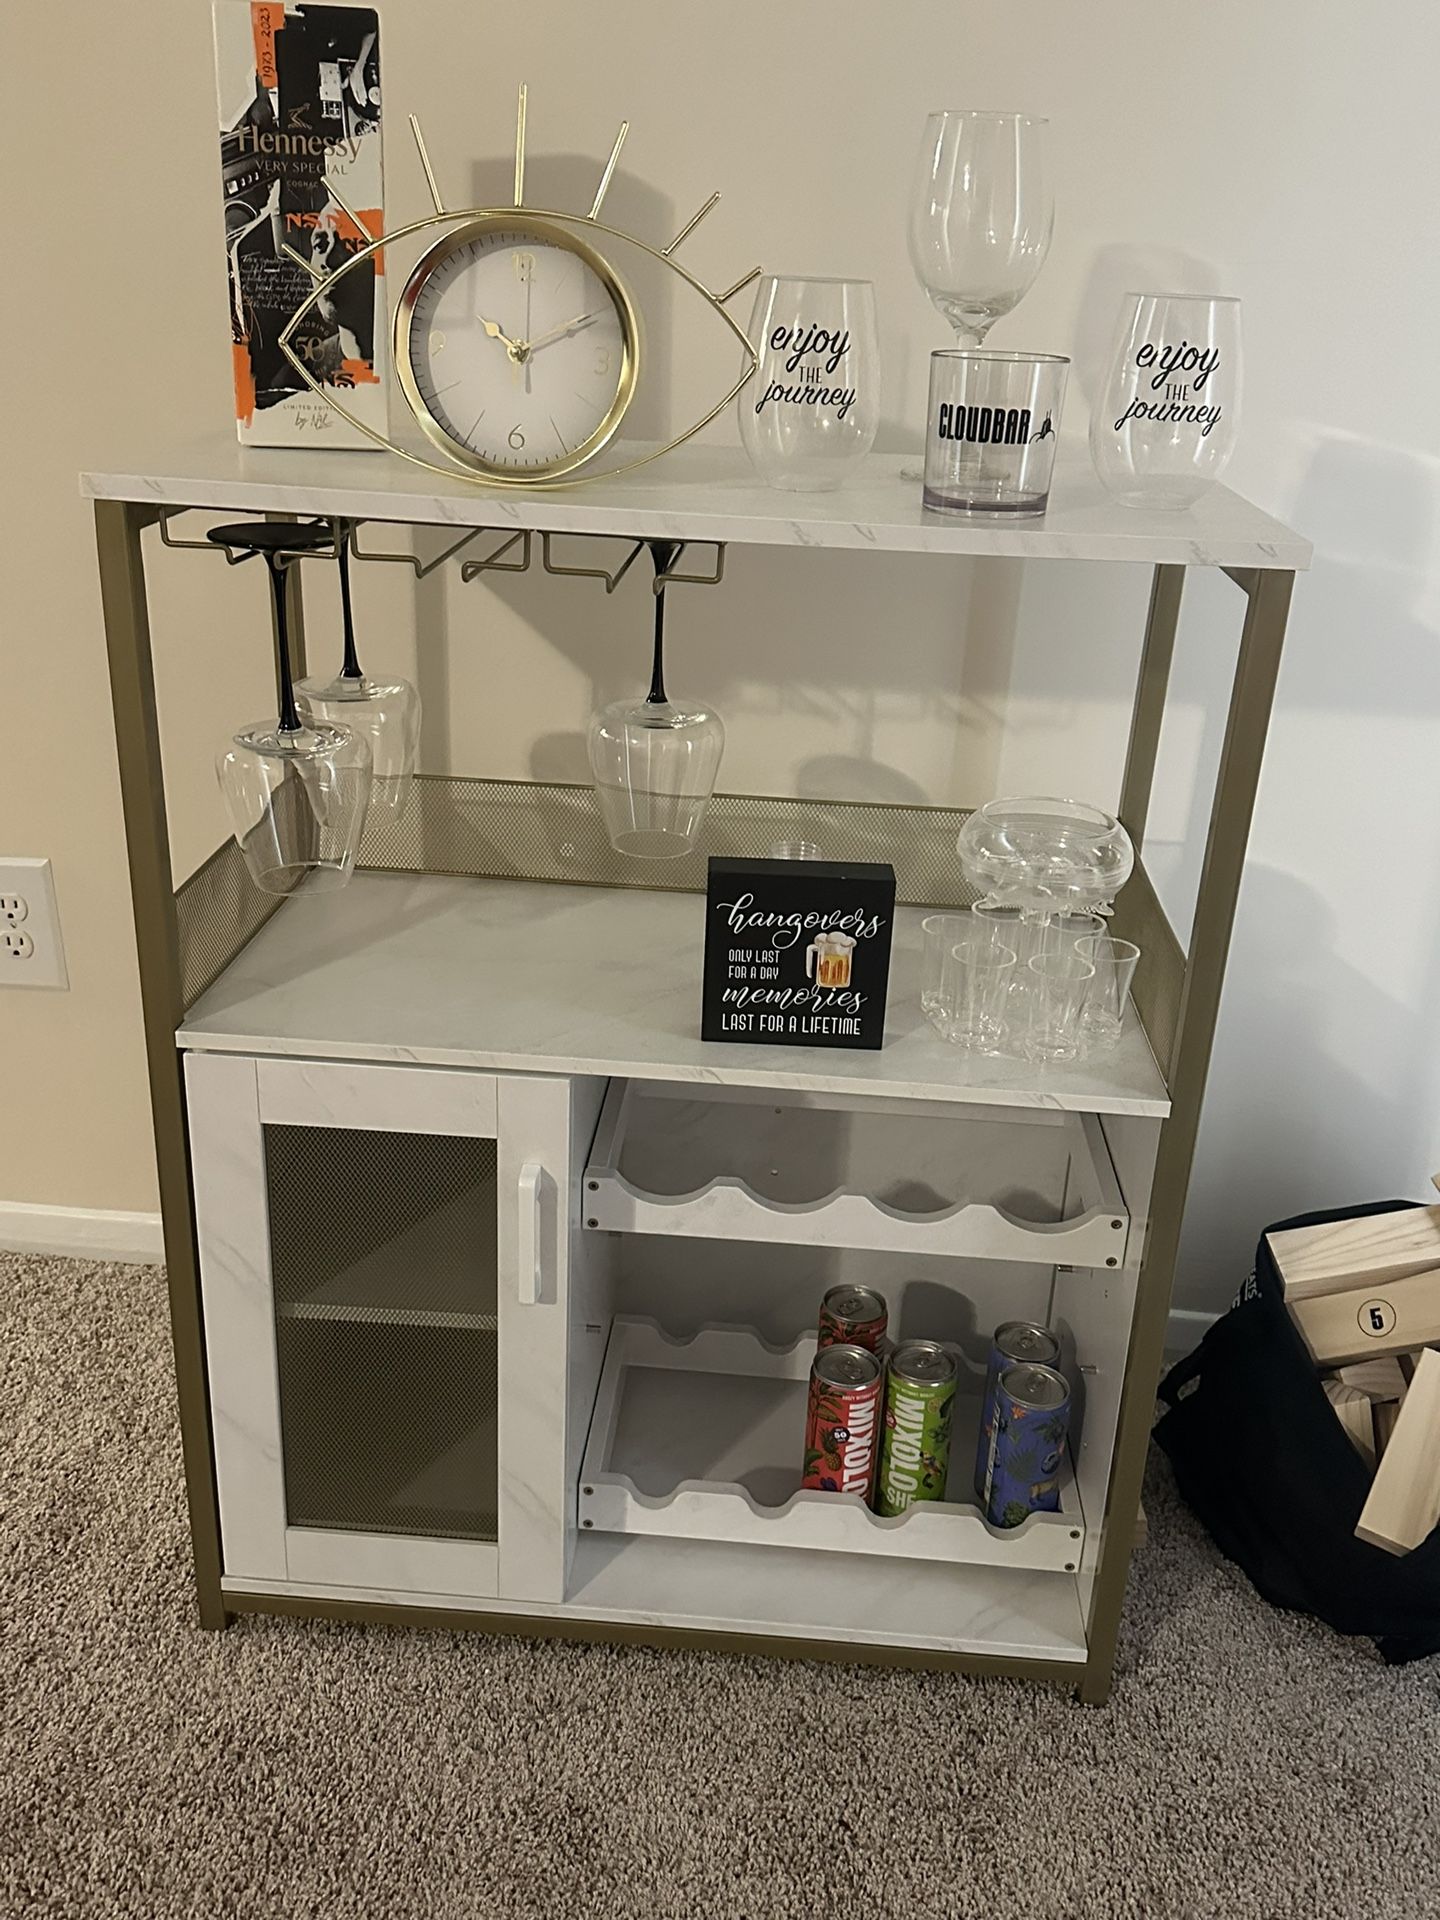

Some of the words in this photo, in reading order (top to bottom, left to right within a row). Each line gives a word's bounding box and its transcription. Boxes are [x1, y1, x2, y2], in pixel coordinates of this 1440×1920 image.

[260, 7, 272, 37] 2023
[262, 51, 273, 78] 1973
[238, 124, 362, 163] Hennessy
[255, 159, 289, 173] VERY
[292, 161, 349, 175] SPECIAL
[286, 180, 319, 188] COGNAC
[295, 336, 325, 361] 50
[593, 346, 610, 375] 3
[770, 323, 852, 374] enjoy
[799, 365, 823, 384] THE
[1135, 340, 1220, 391] enjoy
[755, 379, 857, 420] journey
[1164, 383, 1191, 402] THE
[283, 403, 312, 411] LIMITED
[1114, 397, 1223, 437] journey
[508, 423, 525, 450] 6
[938, 402, 1032, 445] CLOUDBAR
[716, 893, 887, 950] hangovers
[728, 949, 752, 963] ONLY
[755, 950, 781, 964] LAST
[728, 965, 747, 979] FOR
[750, 966, 757, 980] A
[760, 966, 779, 980] DAY
[722, 984, 869, 1015] memories
[722, 1013, 755, 1031] LAST
[759, 1014, 784, 1033] FOR
[788, 1016, 797, 1033] A
[801, 1016, 862, 1036] LIFETIME
[1369, 1307, 1384, 1331] 5
[834, 1431, 848, 1439] 50
[889, 1393, 925, 1491] MIXOLO
